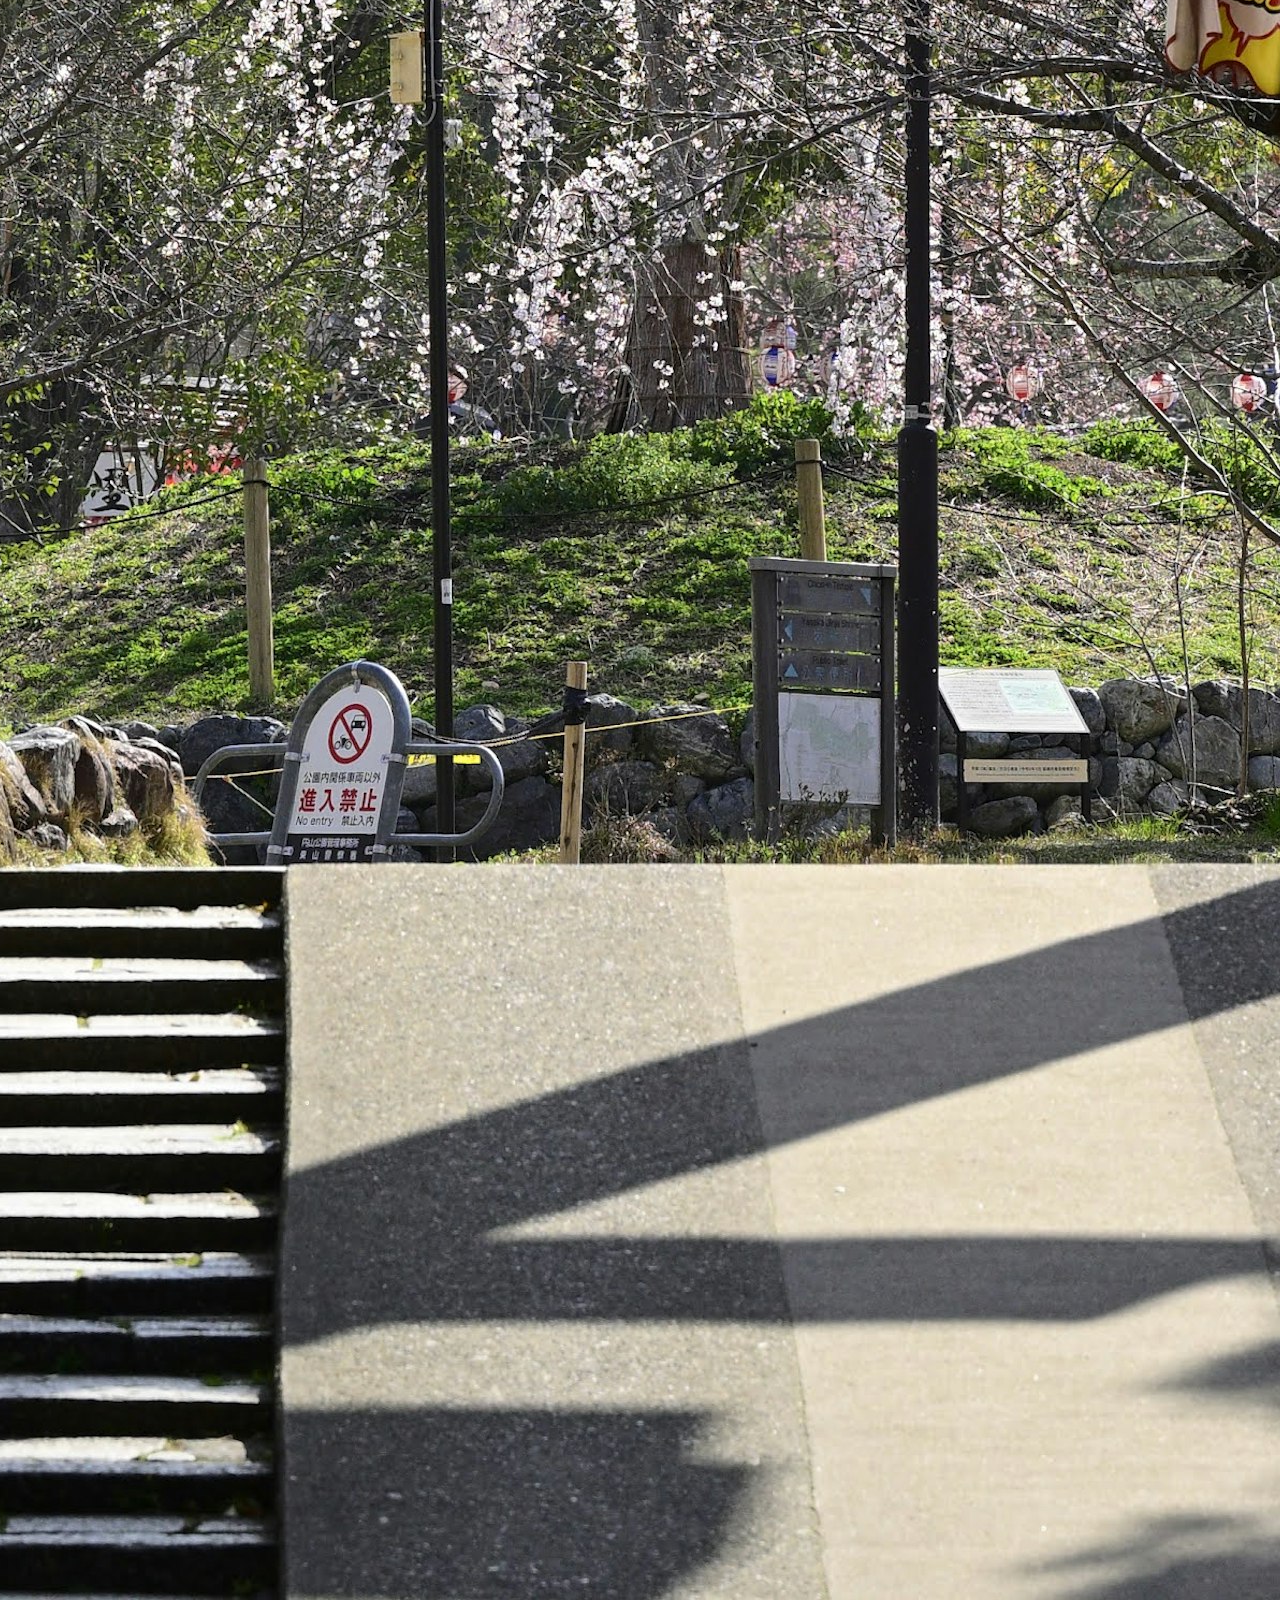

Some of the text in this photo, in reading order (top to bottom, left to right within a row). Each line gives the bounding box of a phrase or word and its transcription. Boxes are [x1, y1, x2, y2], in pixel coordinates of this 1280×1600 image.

[298, 787, 377, 812] 進入禁止
[295, 815, 308, 826] No
[310, 816, 334, 827] entry
